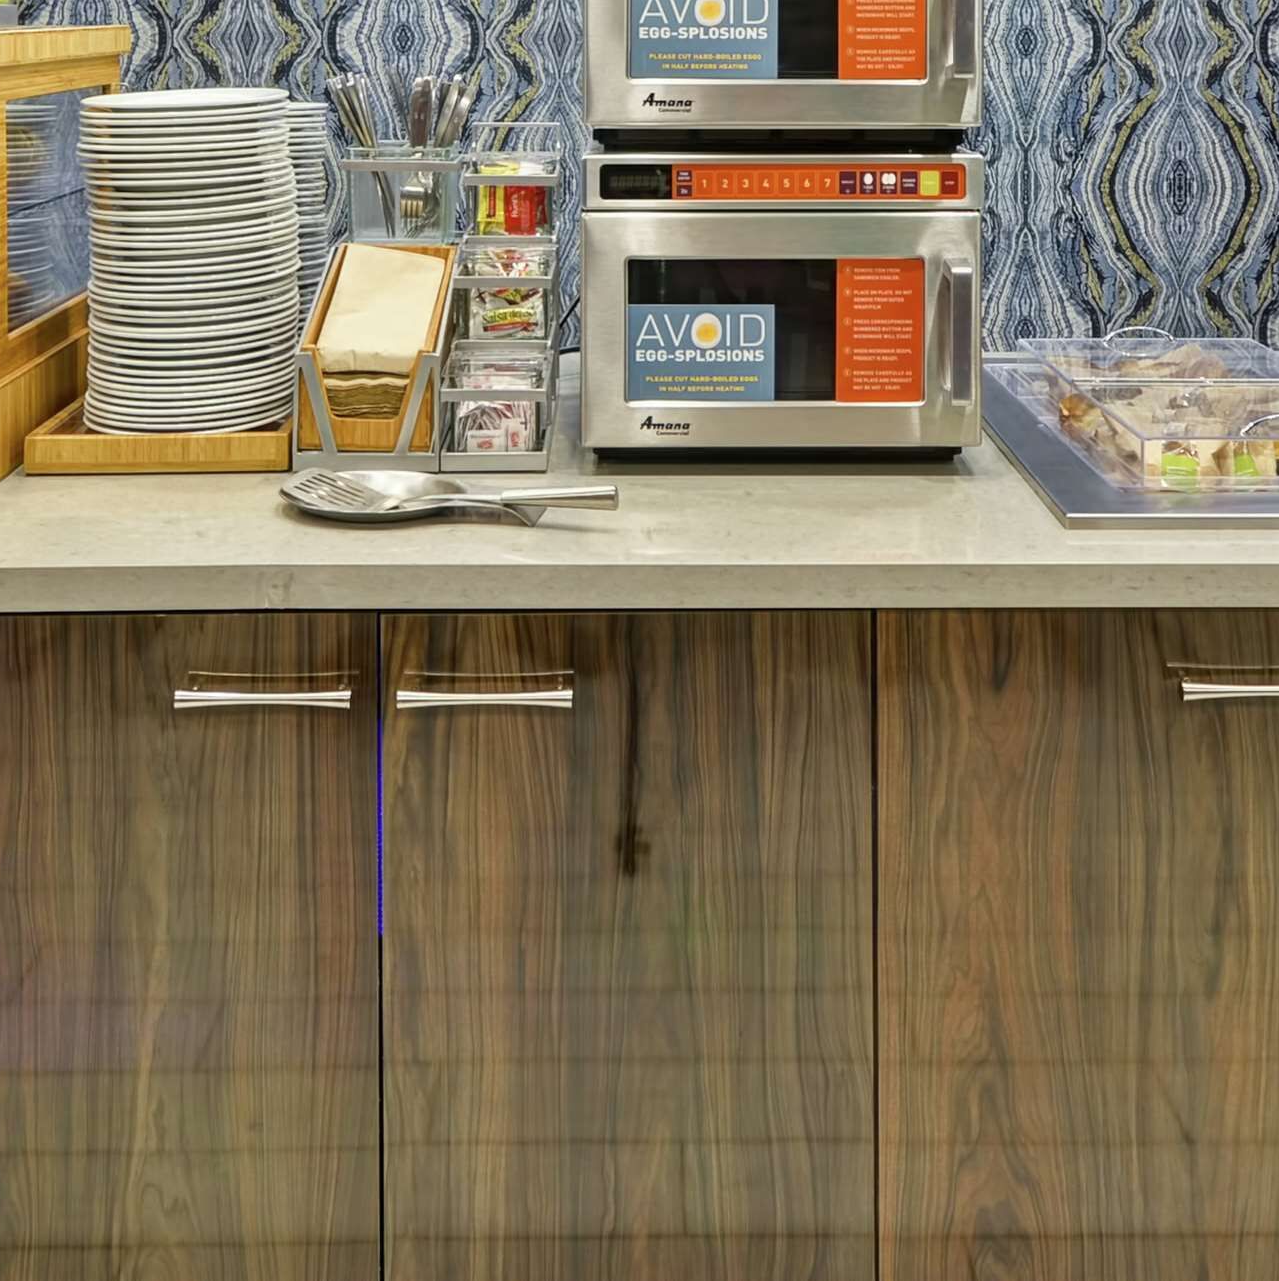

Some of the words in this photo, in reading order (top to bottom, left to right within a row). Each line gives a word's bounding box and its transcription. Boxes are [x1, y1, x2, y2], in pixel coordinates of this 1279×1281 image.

[639, 27, 768, 39] EGG-SPLOSIONS
[642, 92, 694, 107] Amana
[636, 313, 765, 349] AVOID
[636, 349, 764, 361] EGG-SPLOSIONS
[640, 415, 690, 430] Amana
